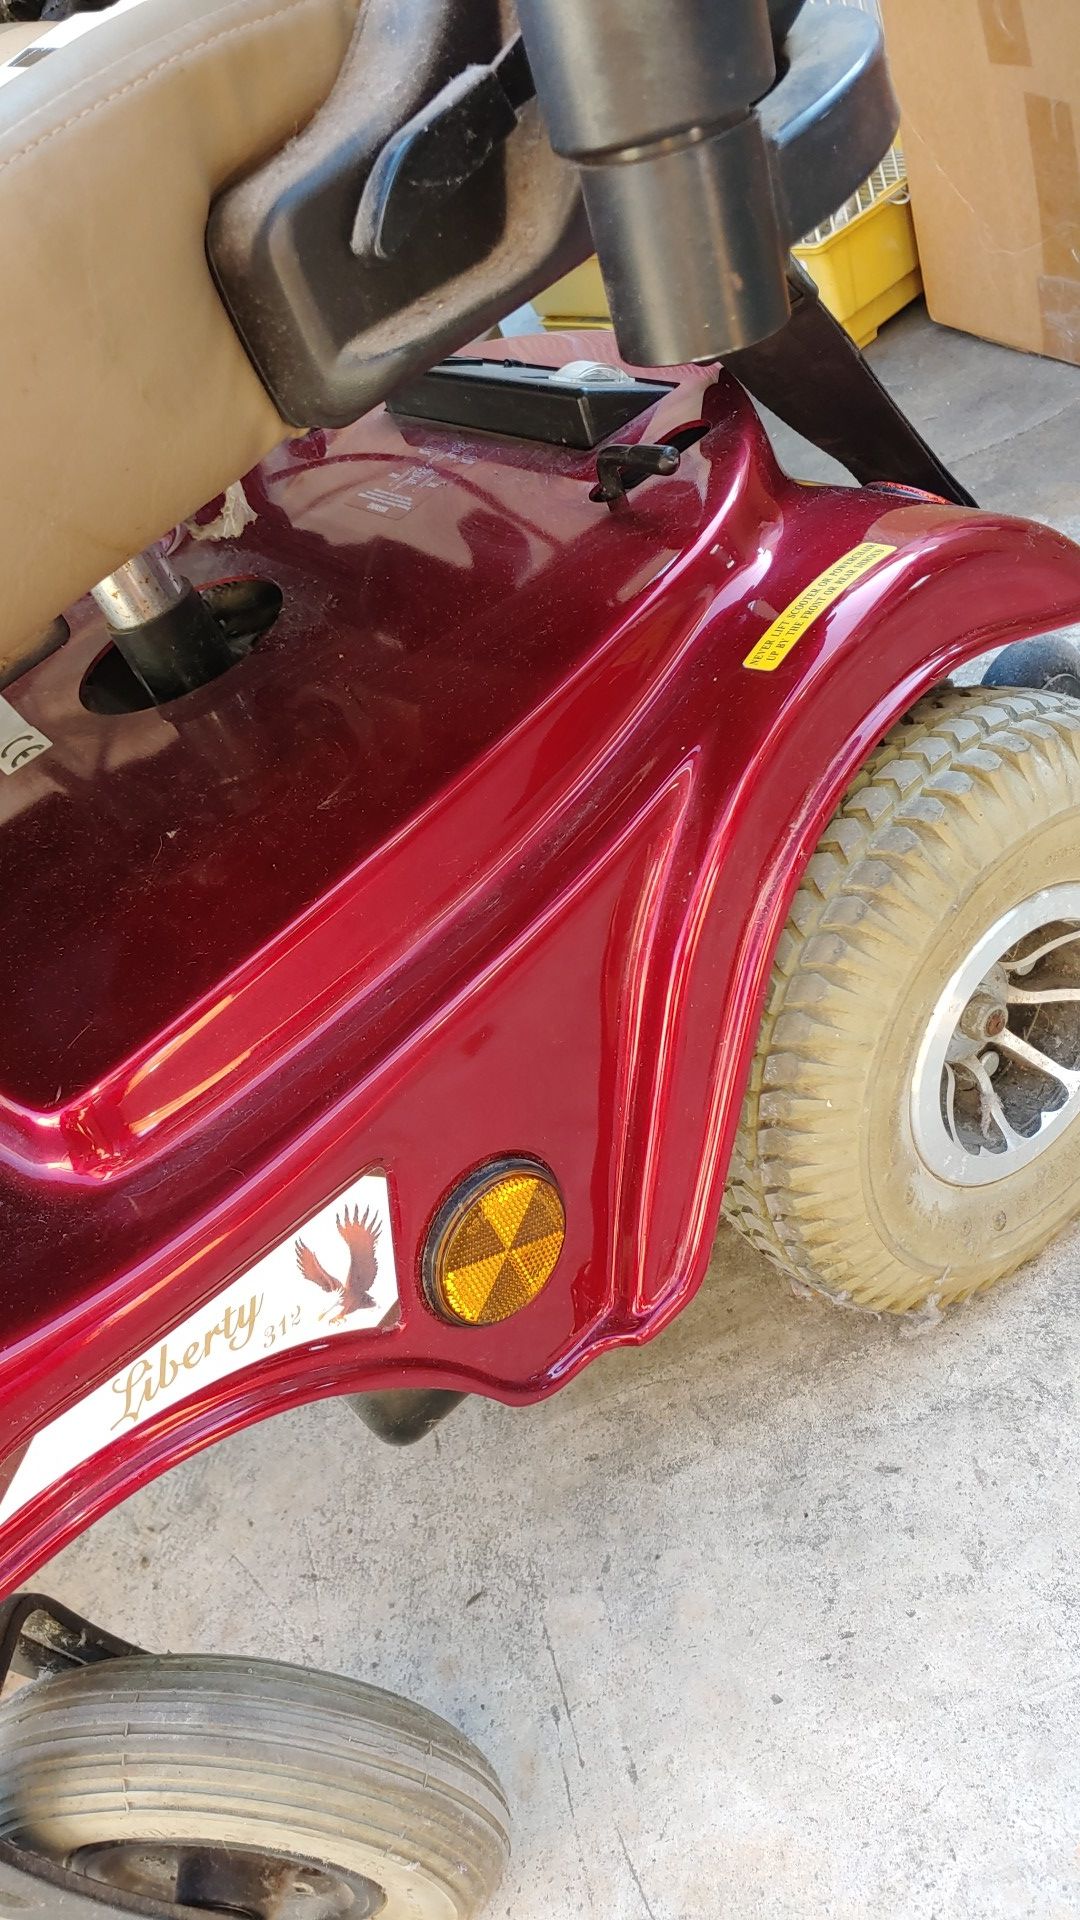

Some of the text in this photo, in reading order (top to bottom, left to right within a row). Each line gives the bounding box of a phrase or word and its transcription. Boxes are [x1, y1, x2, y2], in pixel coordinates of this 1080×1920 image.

[750, 640, 775, 665] NEVER
[772, 620, 790, 637] LIFT
[787, 587, 819, 619] SCOOTER
[818, 578, 832, 590] OR
[766, 650, 779, 661] UP
[776, 639, 789, 649] BY
[786, 621, 804, 636] THE
[801, 597, 827, 619] FRONT
[824, 586, 839, 596] OR
[110, 1292, 301, 1431] Liberty 312
